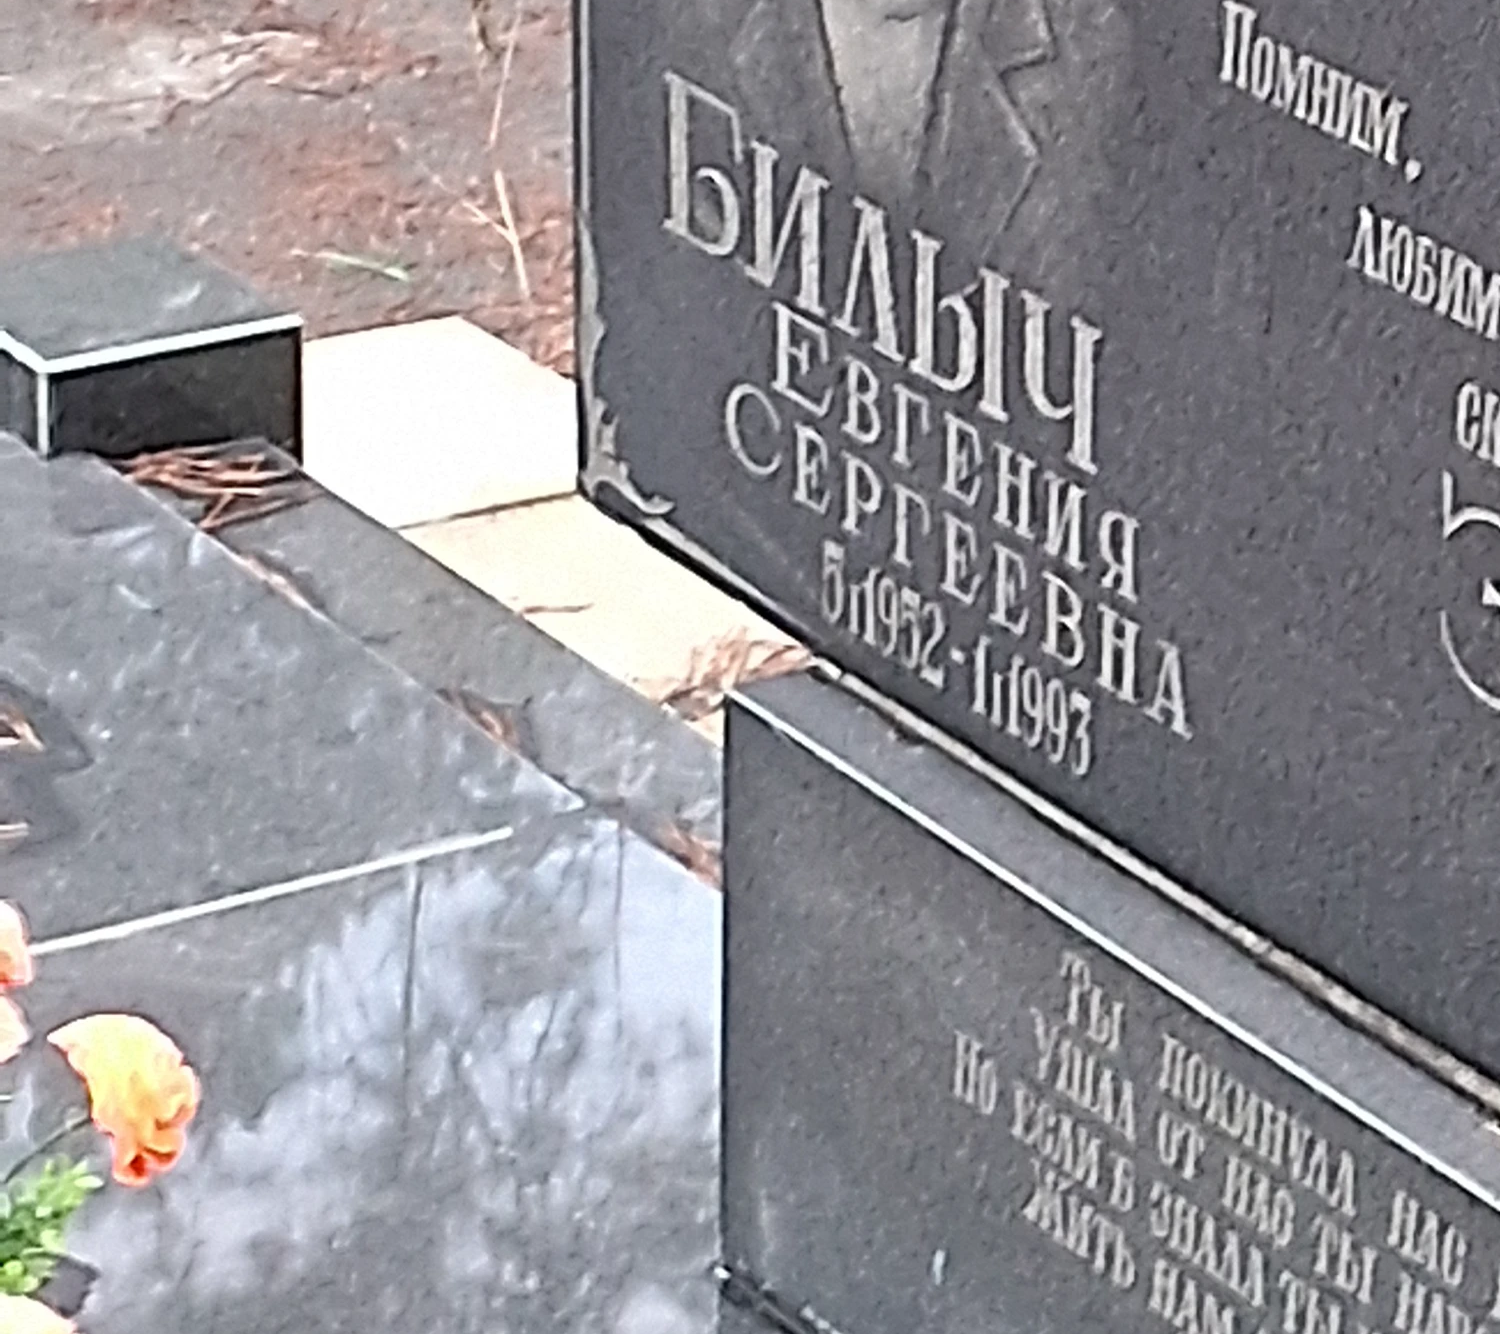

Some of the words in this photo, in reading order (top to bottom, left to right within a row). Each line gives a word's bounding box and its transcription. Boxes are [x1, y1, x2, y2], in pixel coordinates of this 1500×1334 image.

[662, 70, 1102, 475] БИЛЫЧ
[724, 382, 1194, 742] СЕРГЕЕВНА
[771, 301, 1139, 603] ЕВГЕНИЯ
[954, 1030, 997, 1115] НО
[1012, 1080, 1101, 1190] ЕСЛИ
[1150, 1180, 1264, 1308] ЗНАЛА
[1022, 1158, 1137, 1289] ЖИТЬ
[1030, 1006, 1136, 1142] УШЛА
[1158, 1112, 1204, 1180] ОТ
[1222, 1156, 1295, 1248] НАС
[1311, 1215, 1378, 1304] ТЫ
[1060, 950, 1125, 1053] ТЫ
[1159, 1033, 1356, 1217] ПОКИНУЛА
[1387, 1189, 1467, 1287] НАС
